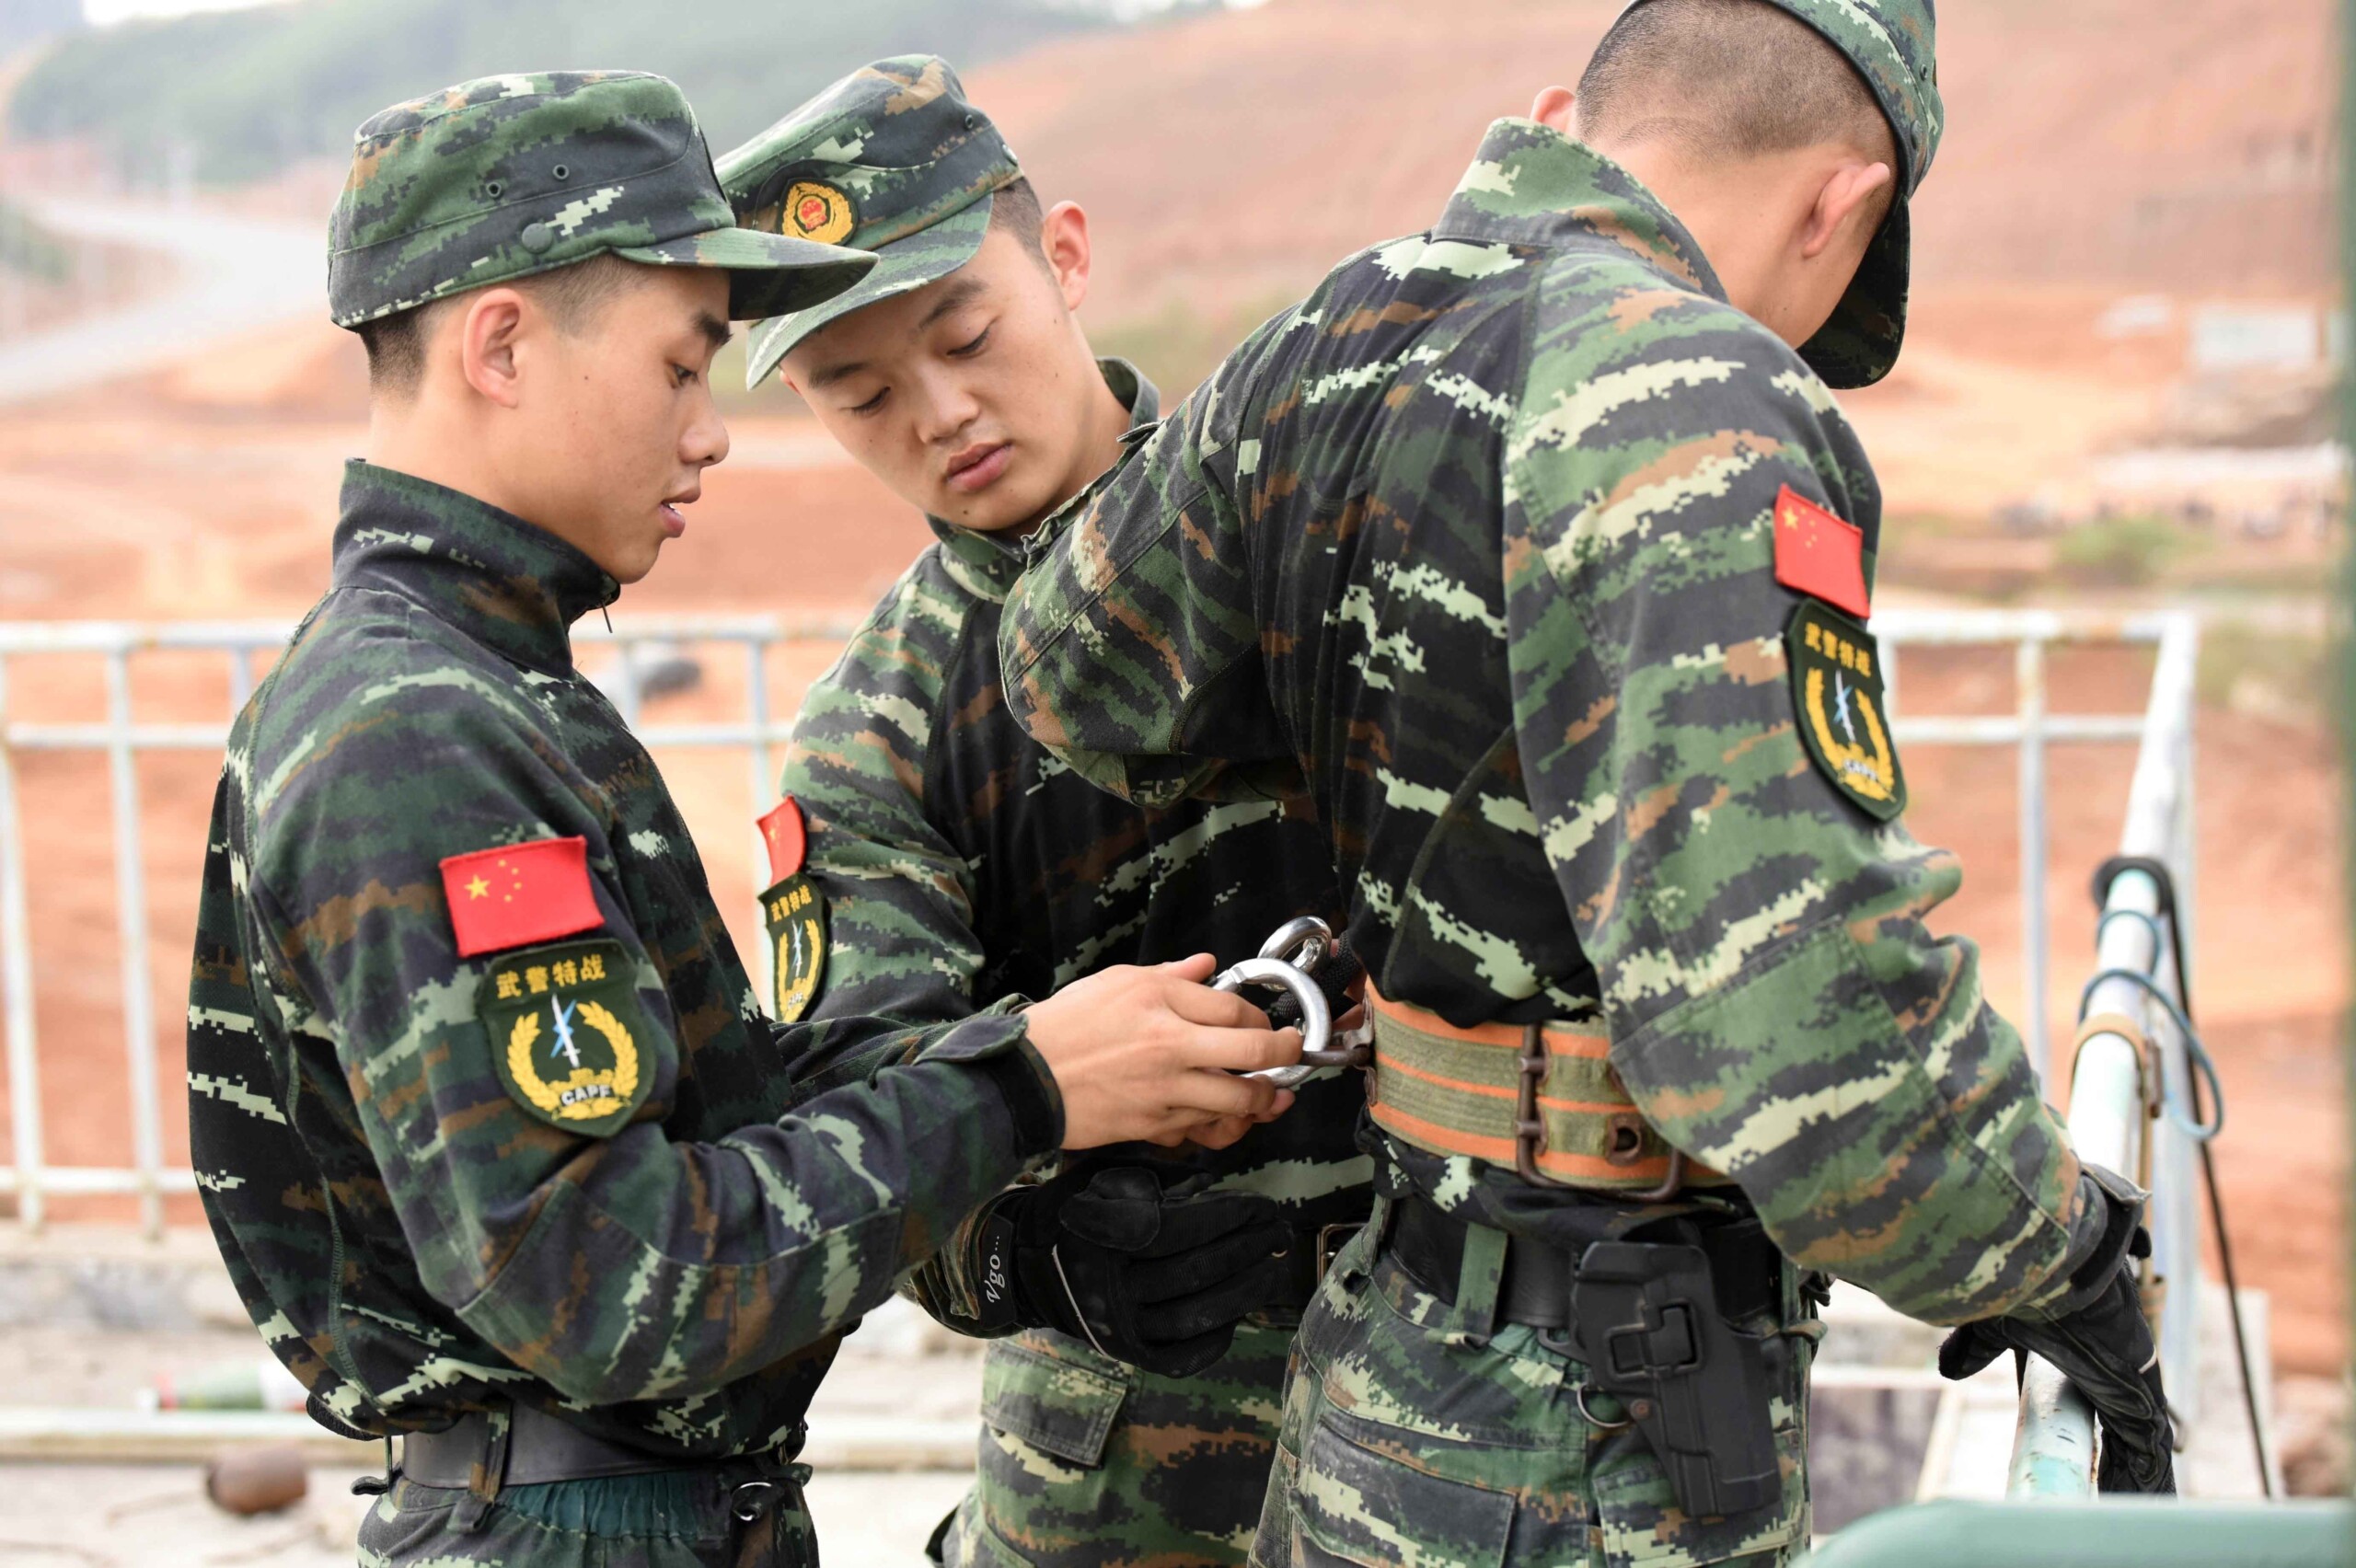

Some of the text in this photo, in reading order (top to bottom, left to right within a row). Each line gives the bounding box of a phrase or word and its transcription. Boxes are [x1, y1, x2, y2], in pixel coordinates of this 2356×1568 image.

[496, 953, 606, 999] 武警特战
[560, 1084, 611, 1106] CAPF
